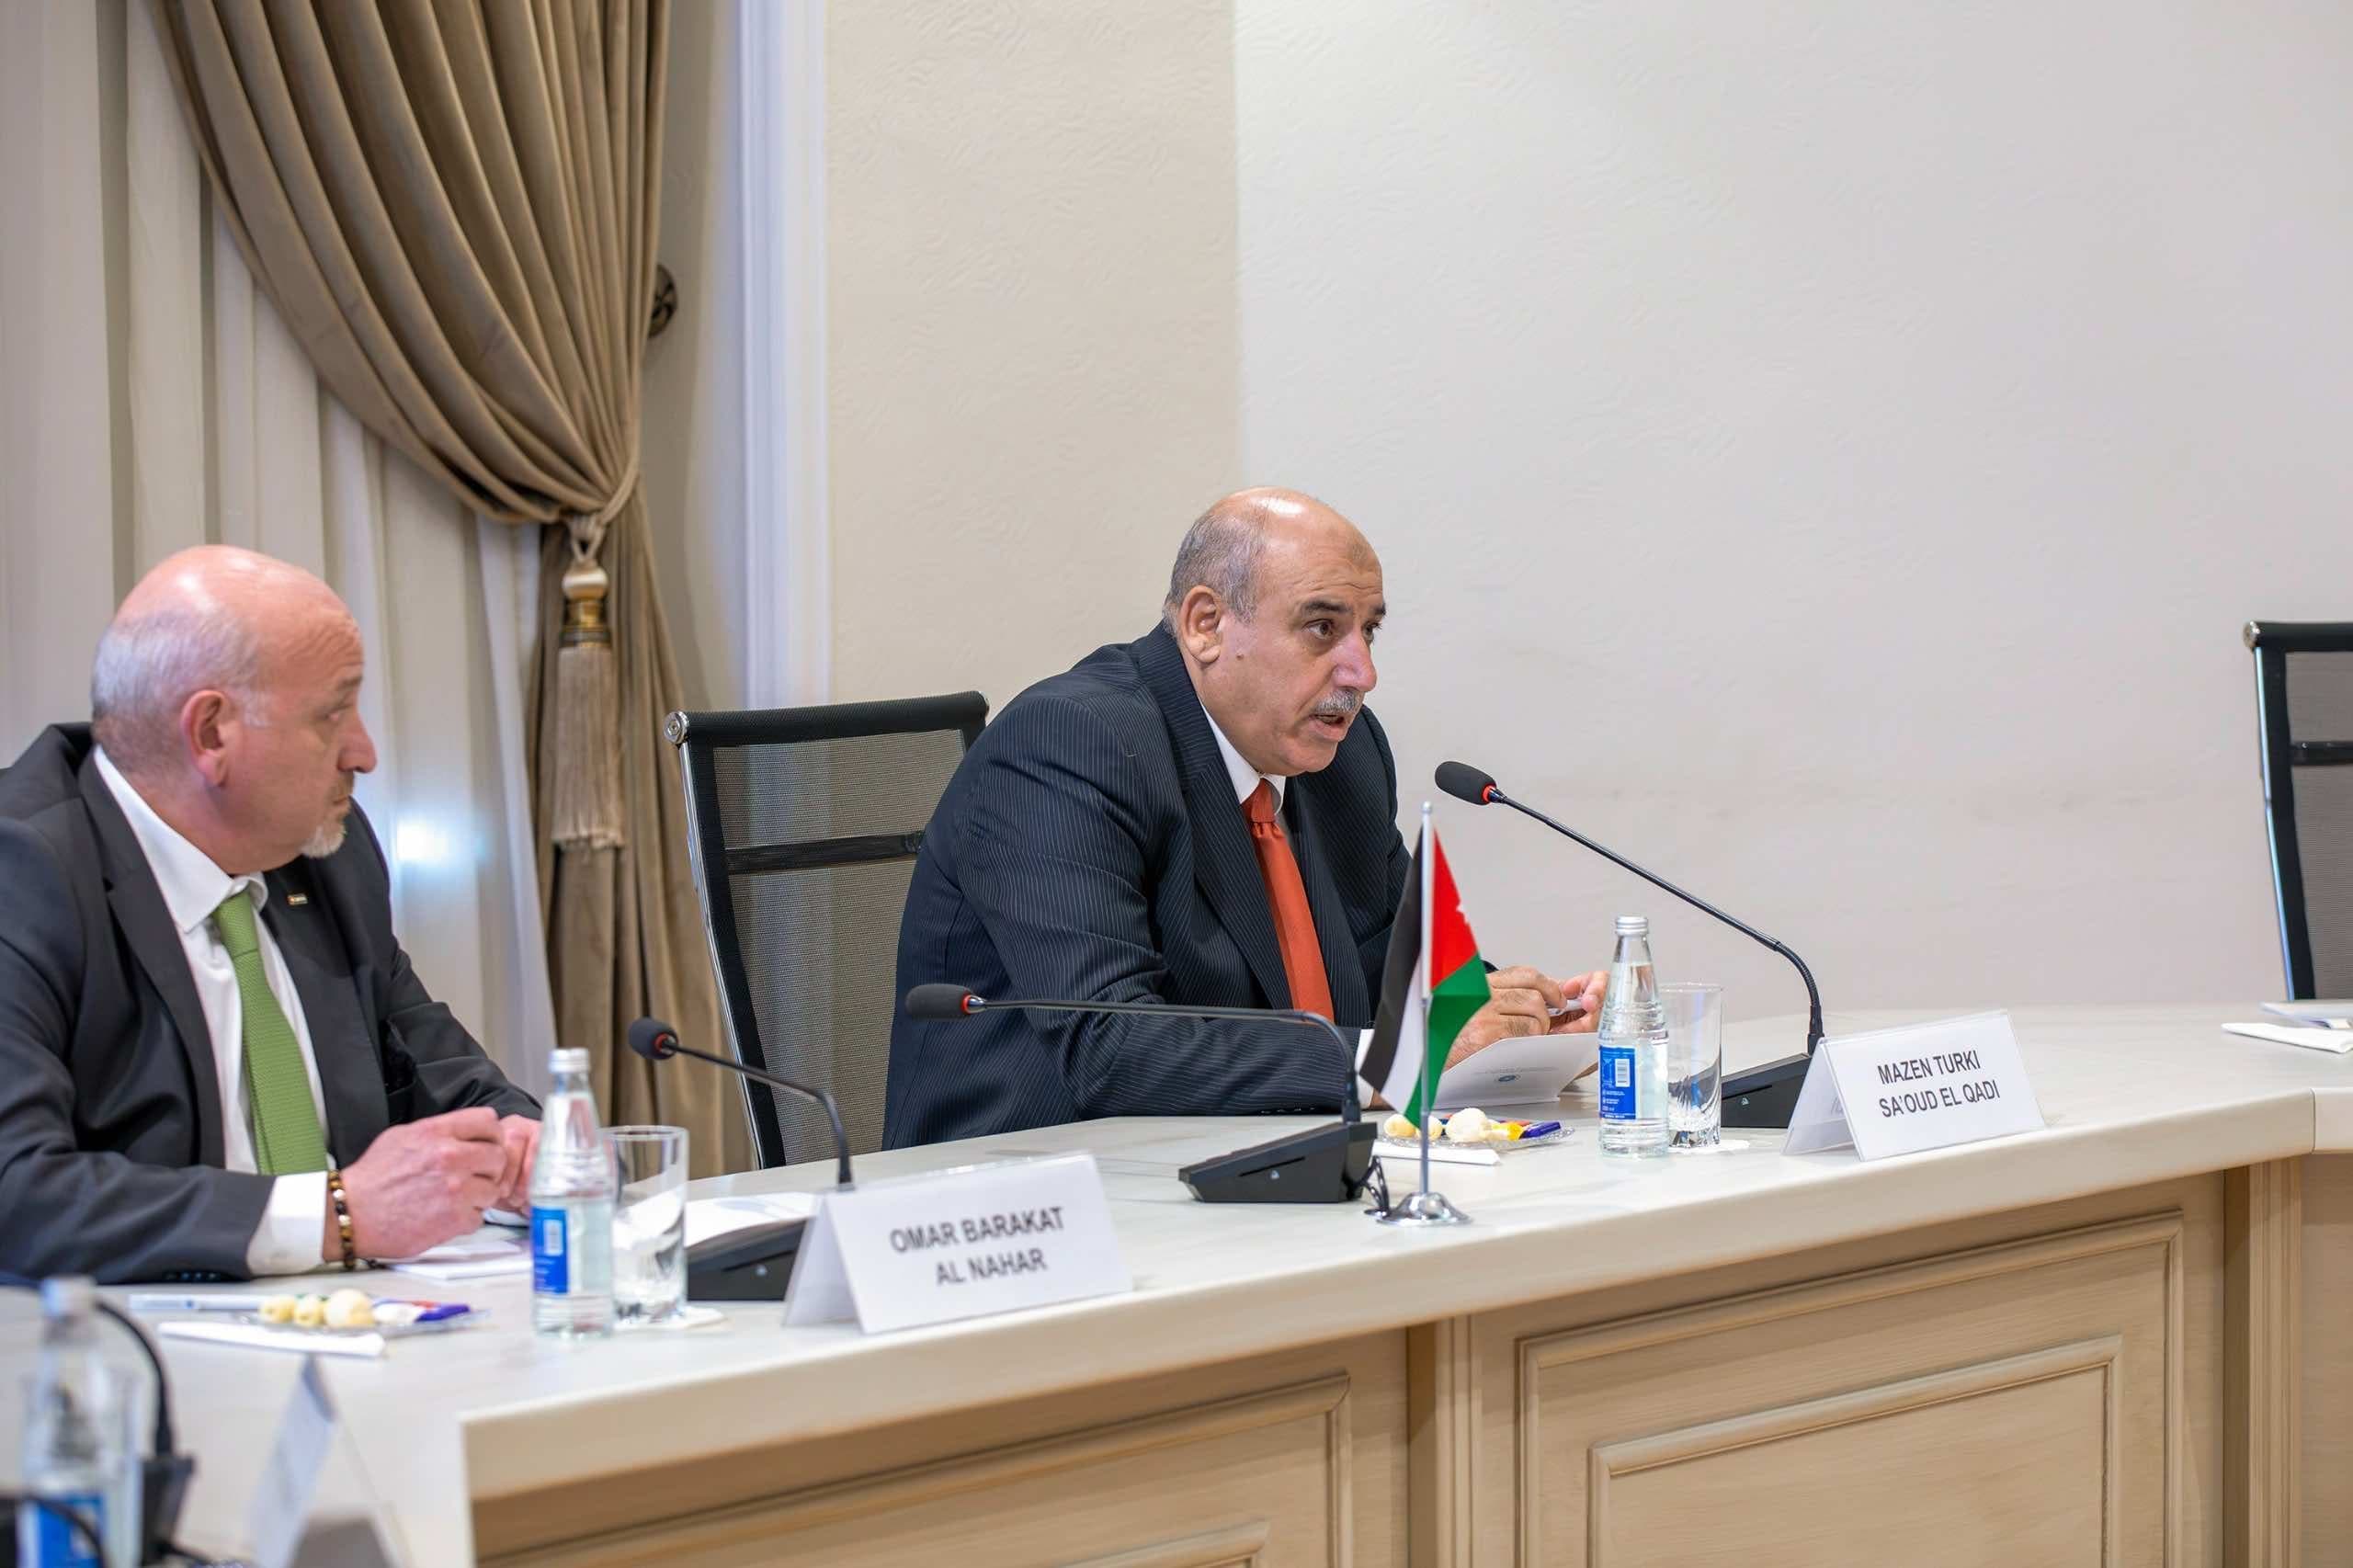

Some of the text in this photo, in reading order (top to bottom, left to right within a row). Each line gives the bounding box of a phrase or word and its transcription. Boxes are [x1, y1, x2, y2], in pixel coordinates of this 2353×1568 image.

[1878, 1050, 1981, 1085] MAZEN TURKI
[1879, 1080, 2001, 1118] SA'OUD EL QADI
[890, 1207, 1064, 1253] OMAR BARAKAT
[937, 1248, 1048, 1285] AL NAHAR
